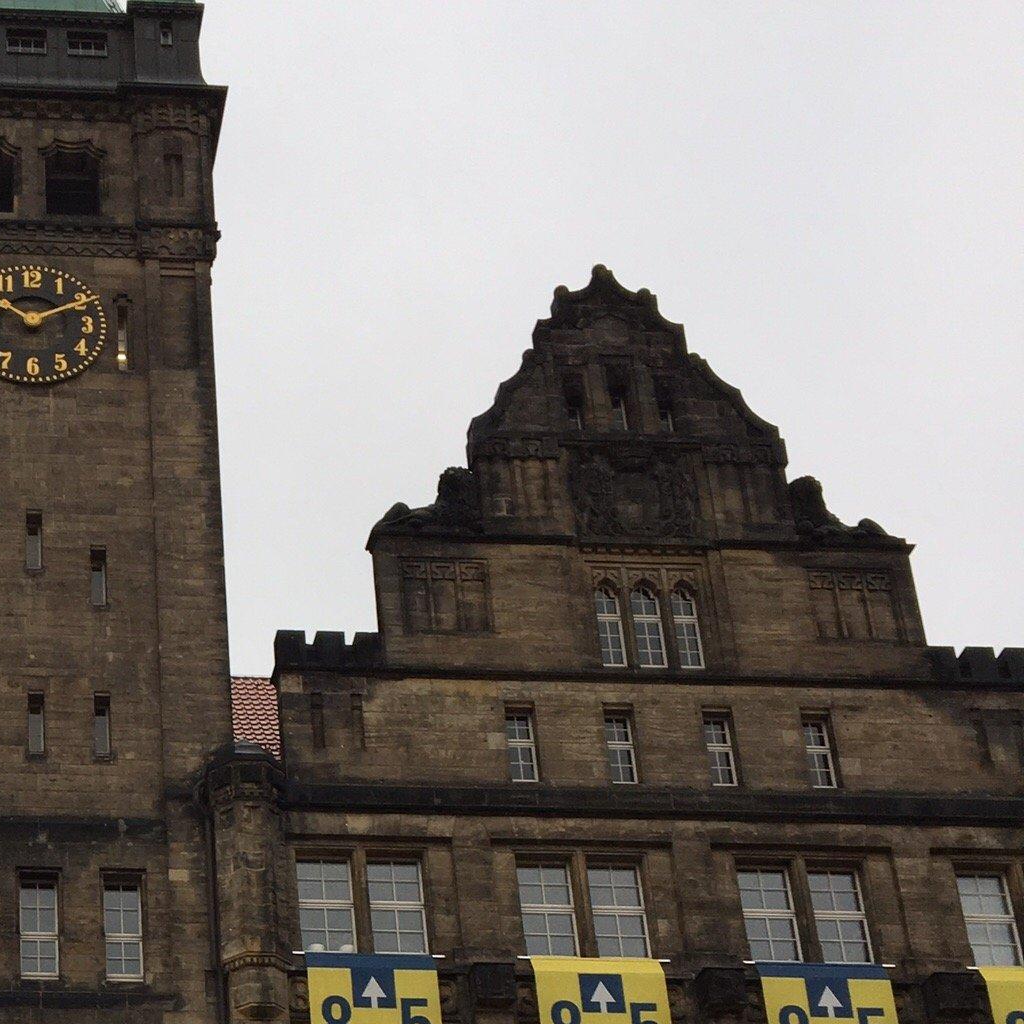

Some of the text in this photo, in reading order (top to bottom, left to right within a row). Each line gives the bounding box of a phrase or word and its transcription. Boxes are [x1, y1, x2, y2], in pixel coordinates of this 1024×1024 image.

[21, 270, 41, 288] 12
[55, 278, 63, 294] 1
[74, 293, 87, 310] 2
[81, 316, 93, 333] 3
[74, 338, 88, 356] 4
[0, 352, 11, 369] 7
[27, 357, 39, 375] 6
[55, 354, 67, 371] 5
